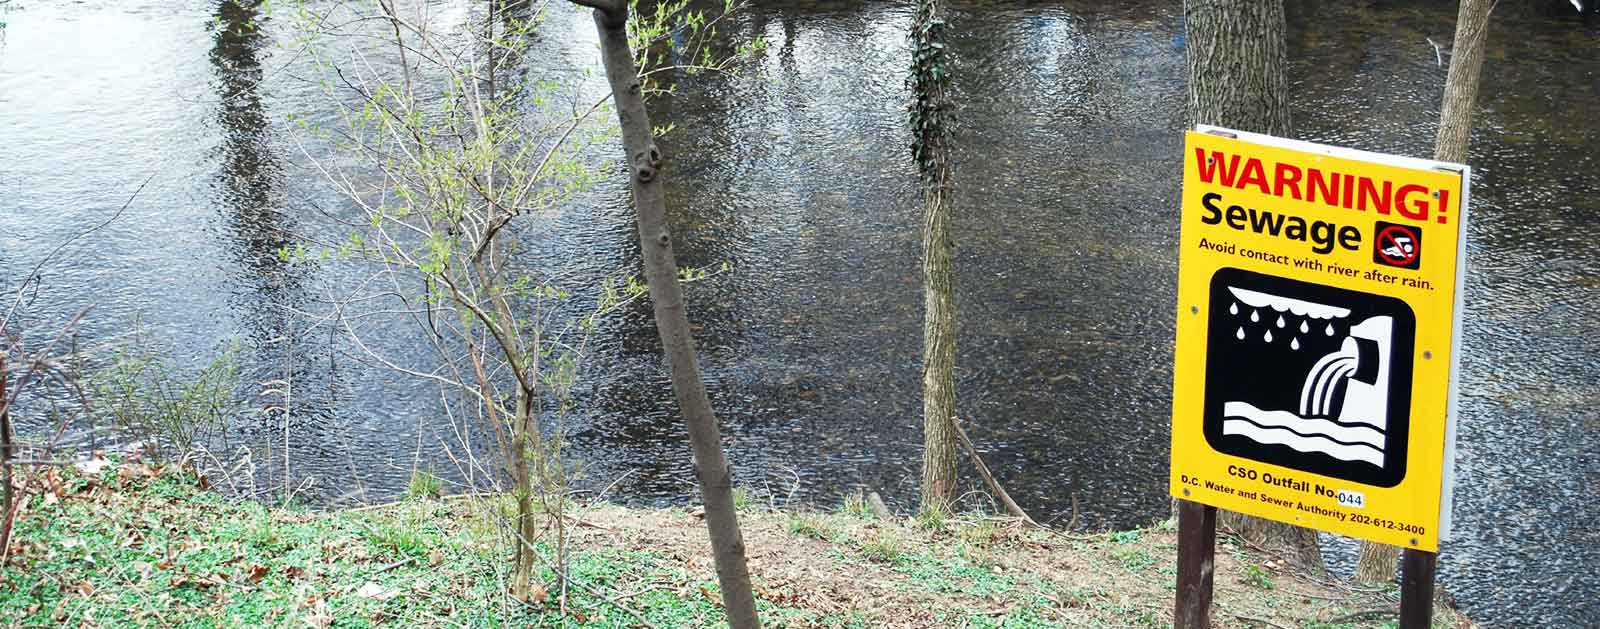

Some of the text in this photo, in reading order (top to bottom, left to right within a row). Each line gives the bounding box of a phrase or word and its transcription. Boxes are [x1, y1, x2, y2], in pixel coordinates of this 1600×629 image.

[1195, 147, 1449, 224] WARNING!
[1201, 192, 1362, 254] Sewage
[1199, 237, 1435, 291] Avoid contact with river after rain.
[1181, 475, 1425, 536] D.C. Water and Sewer Authority 202-612-3400
[1228, 464, 1257, 480] CSO
[1263, 473, 1309, 493] Outfall
[1338, 491, 1362, 506] 044
